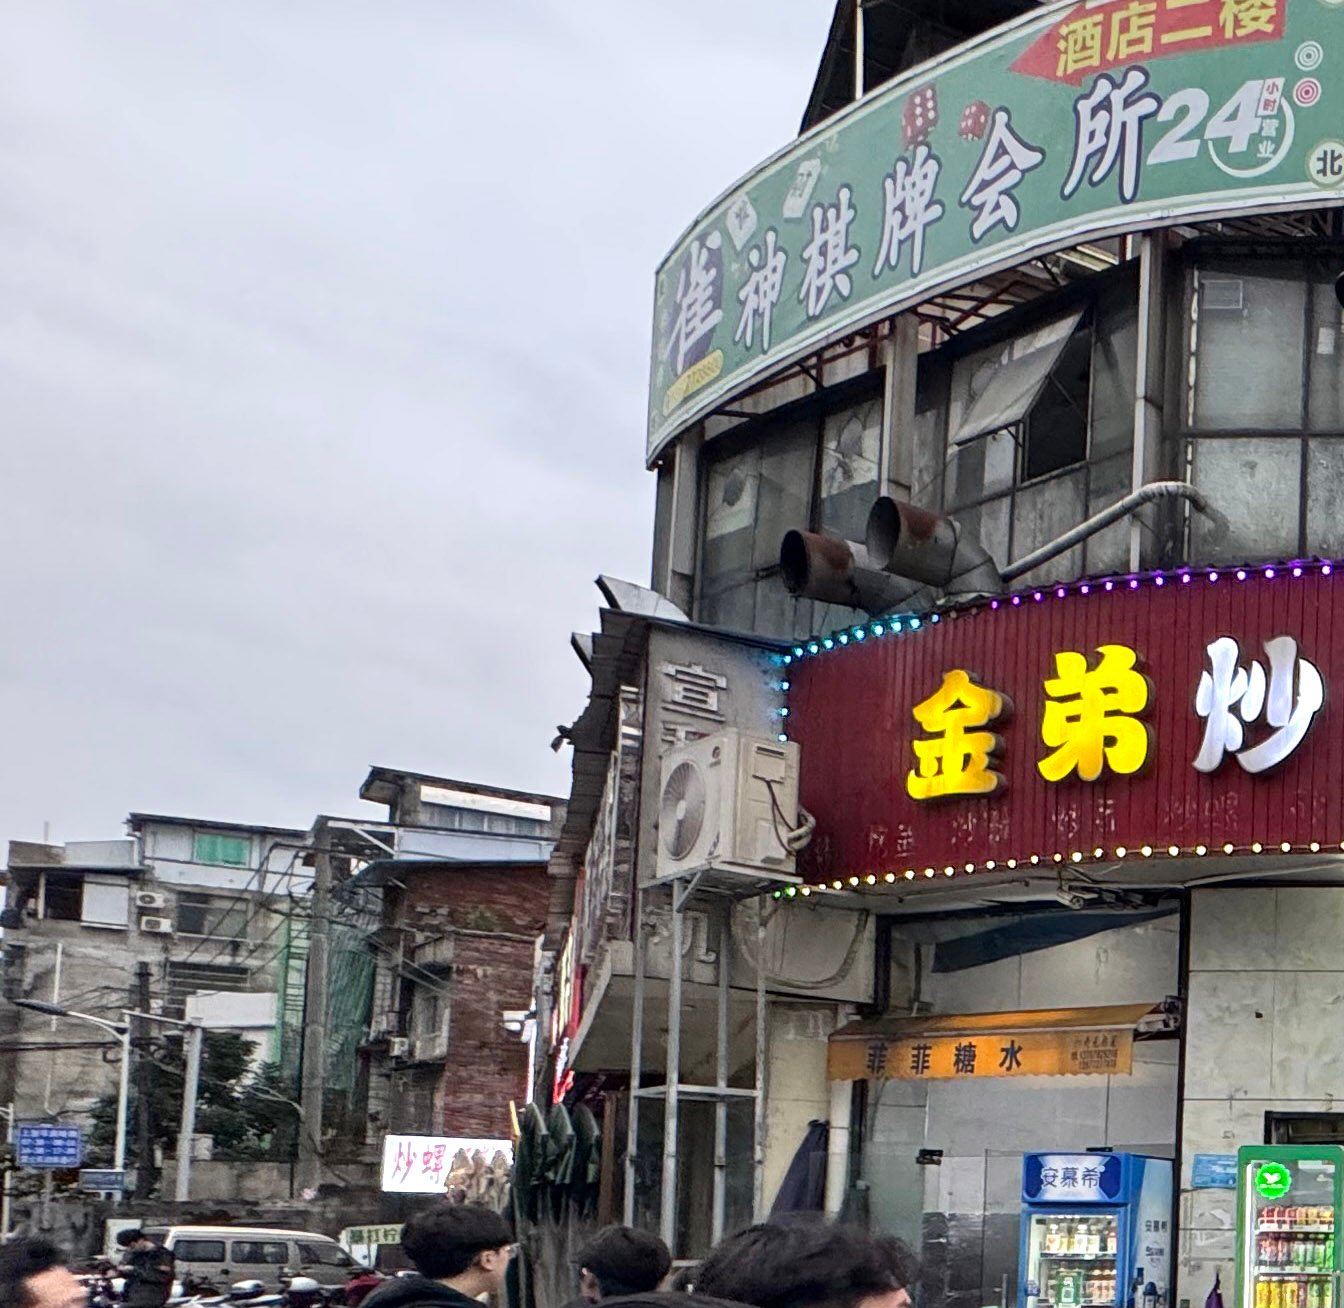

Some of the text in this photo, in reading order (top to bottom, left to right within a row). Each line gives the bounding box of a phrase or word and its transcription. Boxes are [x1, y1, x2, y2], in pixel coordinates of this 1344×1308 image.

[1056, 0, 1277, 77] 酒店二楼
[1146, 80, 1264, 166] 24
[1317, 150, 1343, 178] 北
[867, 1040, 1024, 1075] 菲菲糖水
[1041, 1166, 1101, 1189] 安慕希
